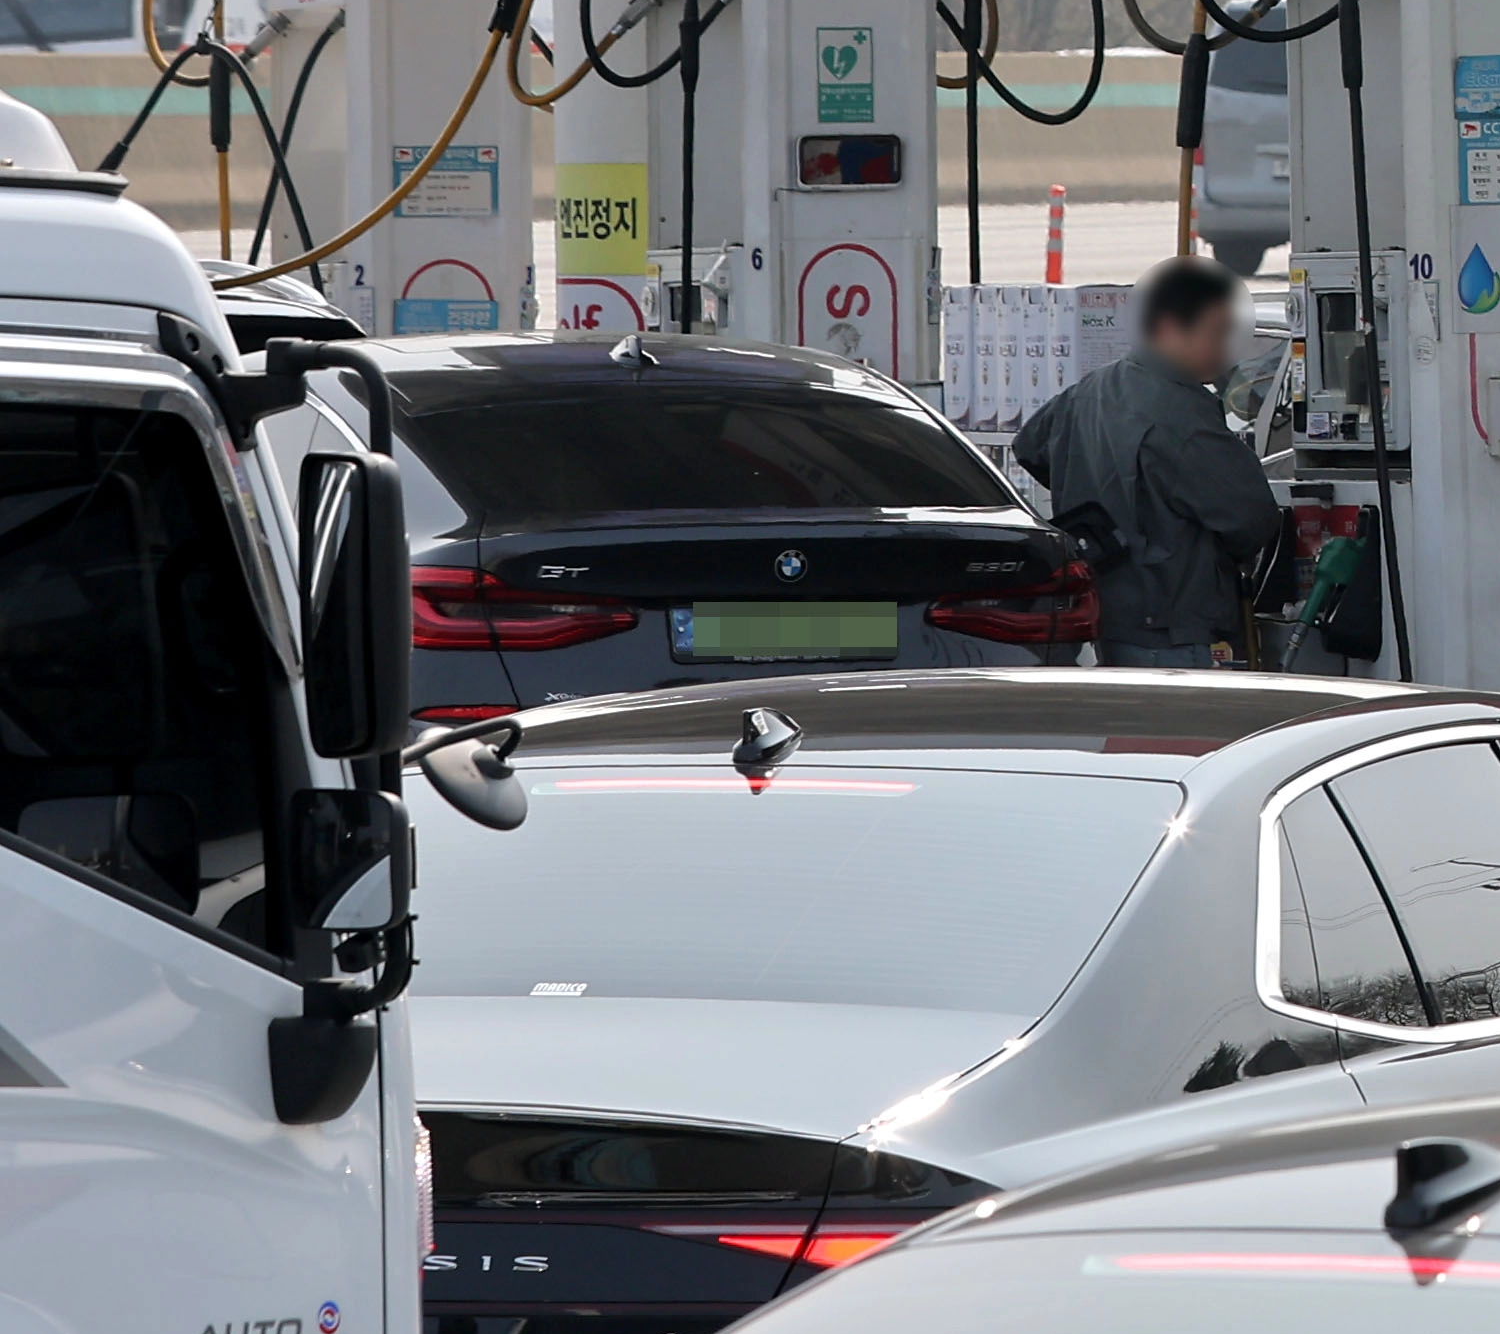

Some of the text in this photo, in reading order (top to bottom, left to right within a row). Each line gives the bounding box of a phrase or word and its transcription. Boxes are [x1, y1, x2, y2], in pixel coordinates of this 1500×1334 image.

[559, 198, 638, 240] 엔진정지
[751, 247, 764, 271] 6
[1409, 252, 1433, 280] 10
[536, 565, 591, 579] GT
